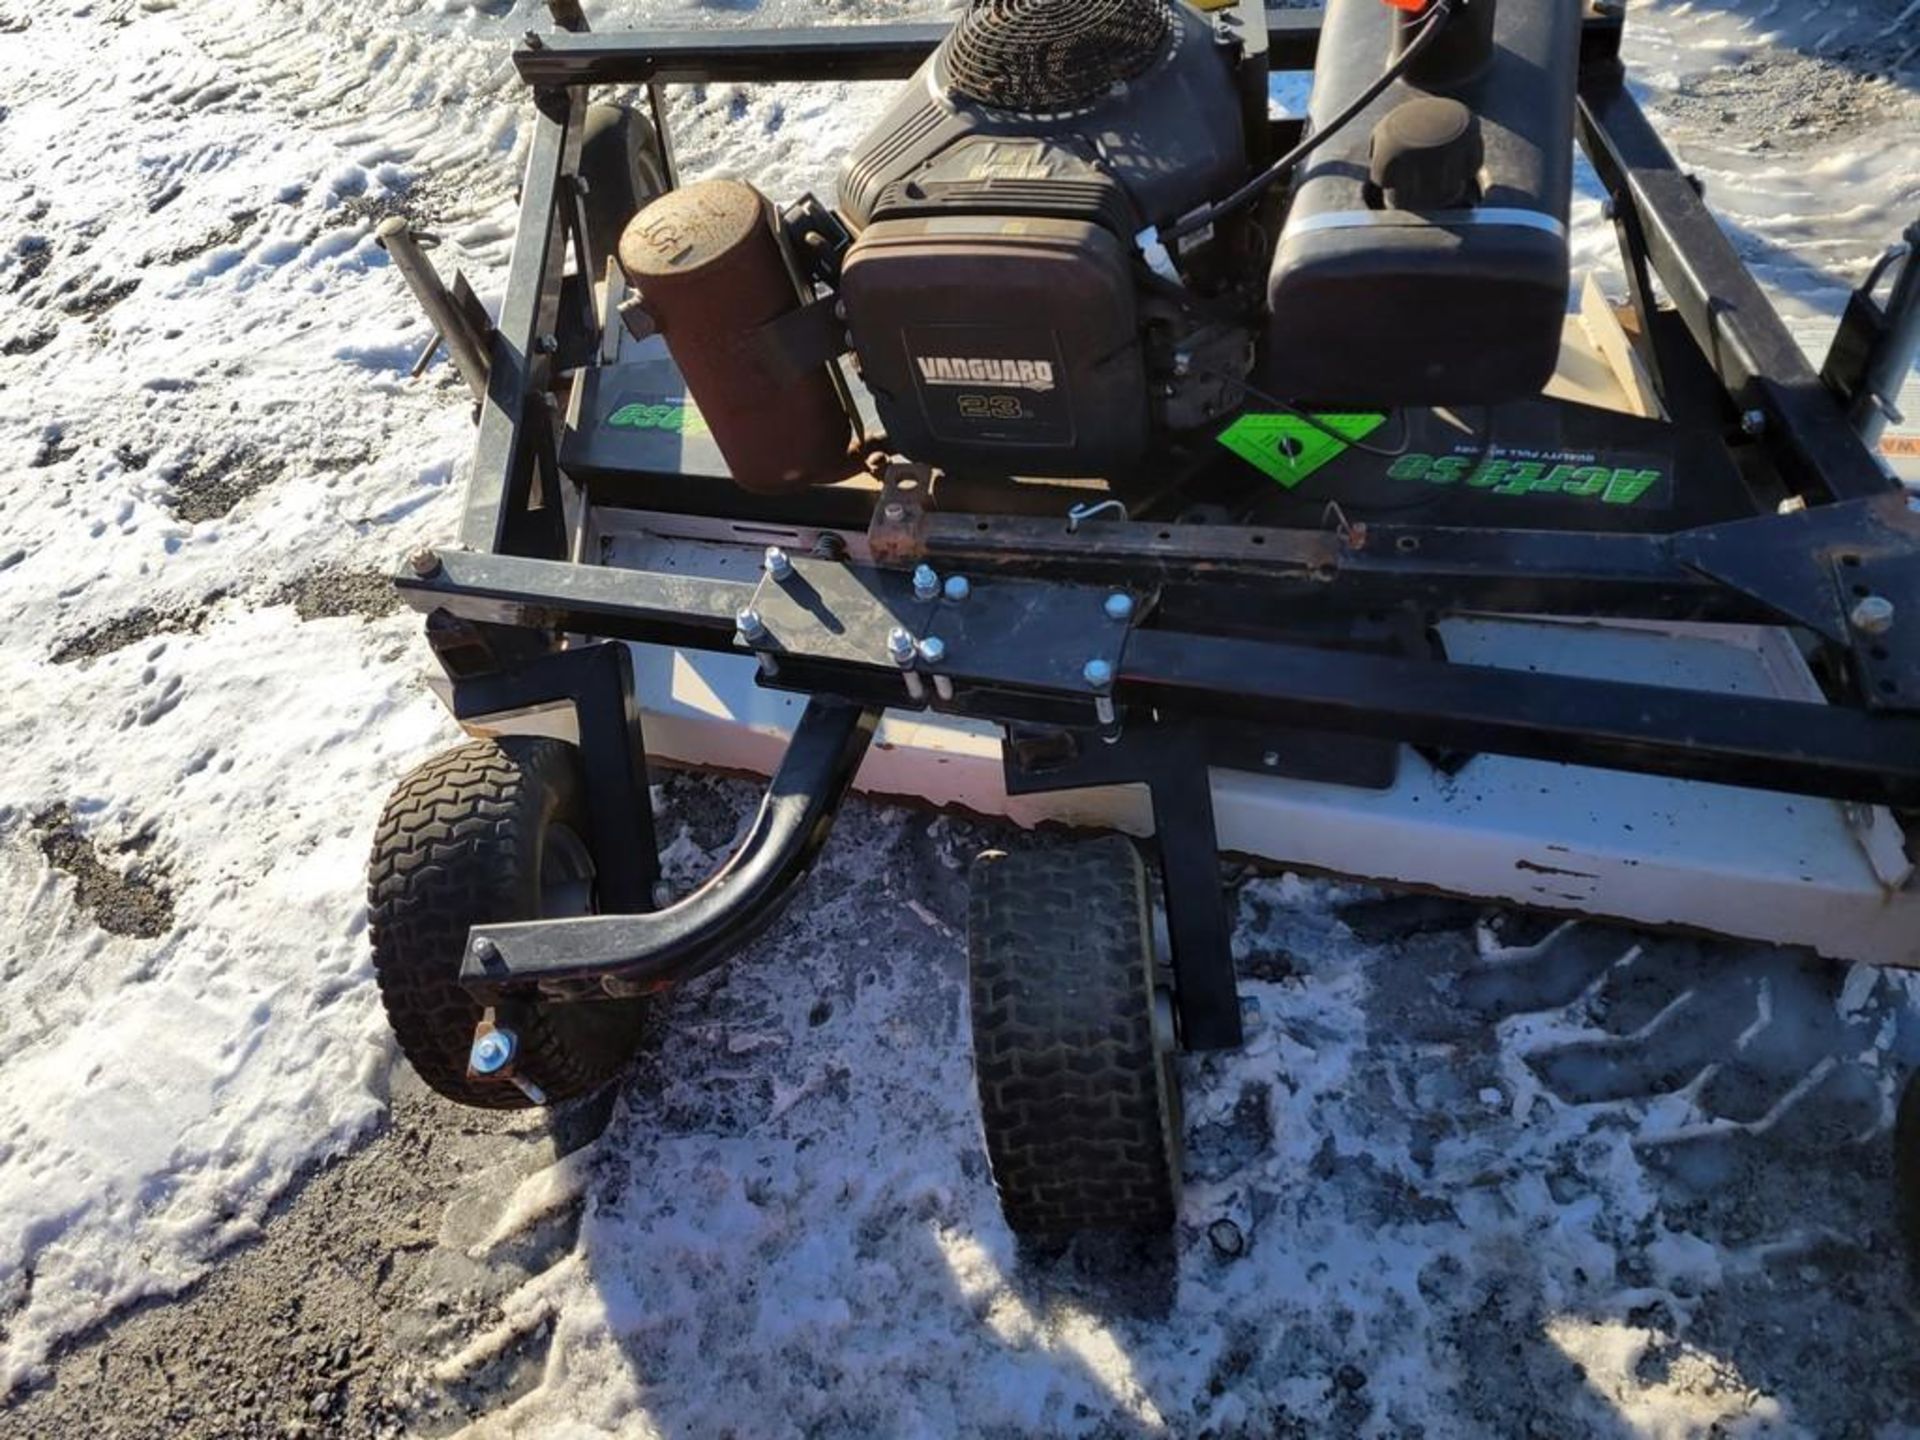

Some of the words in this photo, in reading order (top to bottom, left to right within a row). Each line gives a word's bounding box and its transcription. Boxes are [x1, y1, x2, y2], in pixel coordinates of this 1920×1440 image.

[917, 357, 1053, 382] VANGUARD
[957, 394, 1022, 419] 23
[1541, 451, 1596, 463] QUALITY
